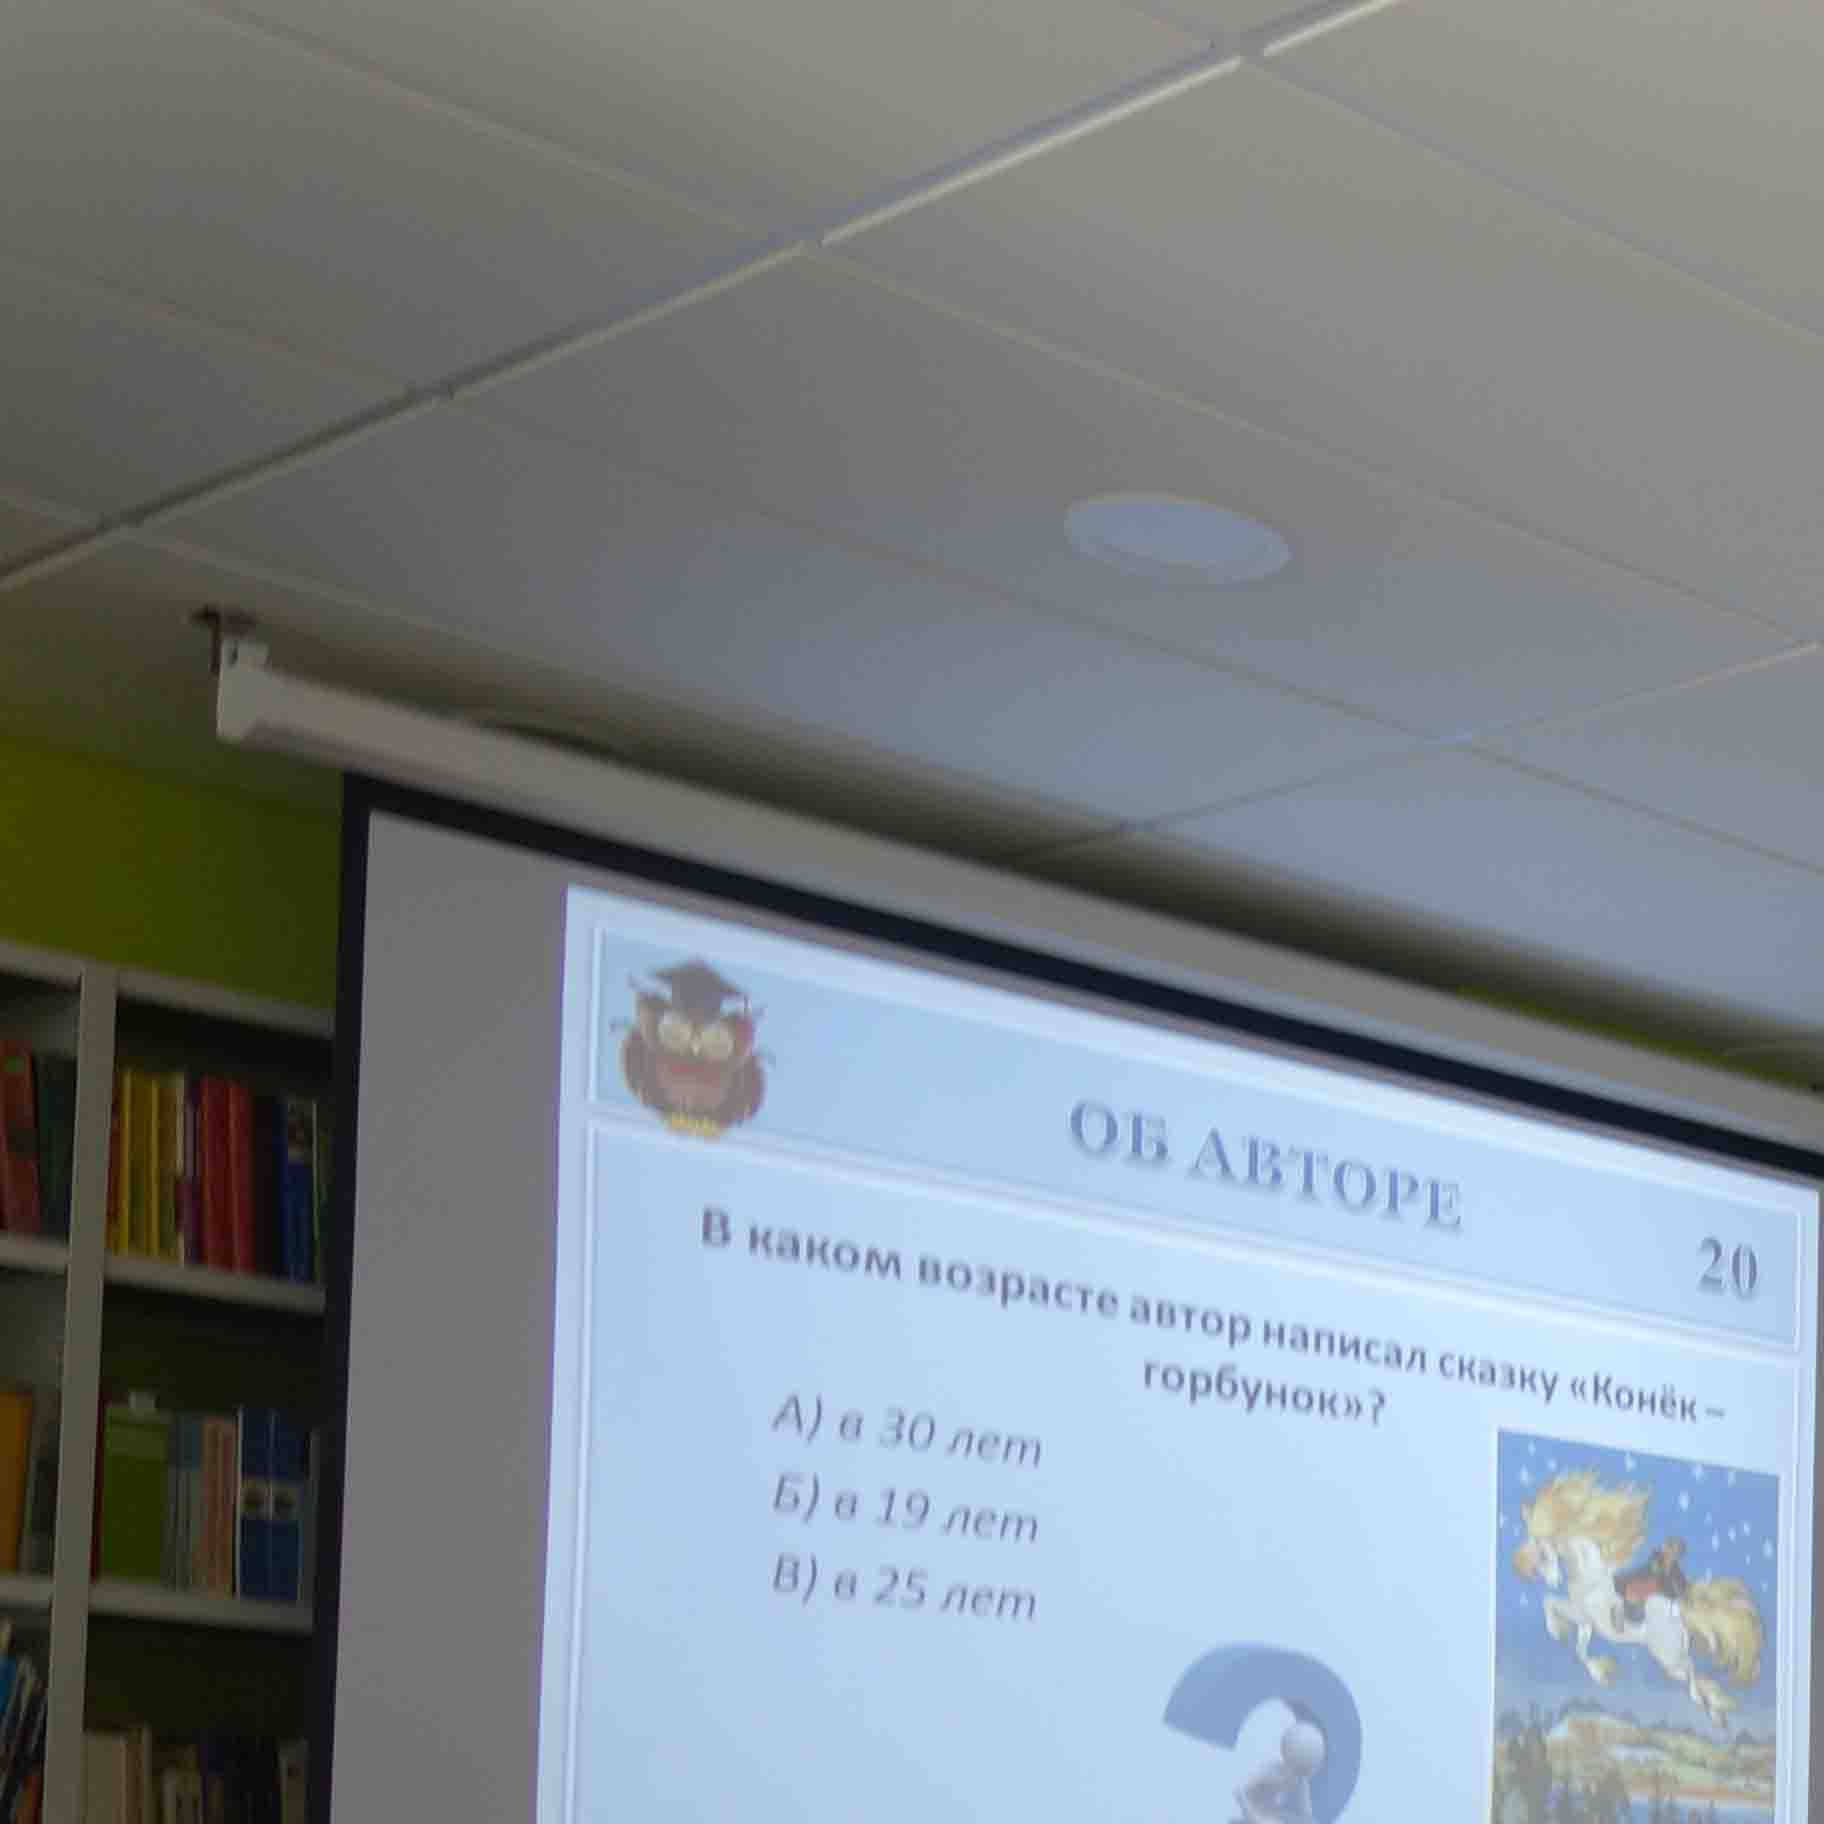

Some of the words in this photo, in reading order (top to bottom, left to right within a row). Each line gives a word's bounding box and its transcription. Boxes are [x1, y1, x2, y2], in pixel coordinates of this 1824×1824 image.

[1069, 1100, 1168, 1163] ОБ
[1190, 1128, 1463, 1229] АВТОРЕ
[1698, 1236, 1758, 1299] 20
[702, 1207, 731, 1247] В
[748, 1224, 902, 1281] каком
[918, 1253, 1118, 1317] возрасте
[1130, 1295, 1252, 1348] автор
[1263, 1318, 1427, 1374] написал
[1438, 1351, 1559, 1405] сказку
[1570, 1371, 1698, 1422] «Конёк
[1143, 1359, 1386, 1426] горбунок»?
[772, 1393, 822, 1446] А)
[839, 1411, 863, 1441] в
[881, 1406, 936, 1452] 30
[946, 1427, 1041, 1468] лет
[773, 1472, 819, 1523] Б)
[835, 1491, 857, 1521] в
[877, 1488, 931, 1529] 19
[943, 1506, 1039, 1542] лет
[773, 1552, 817, 1606] В)
[834, 1570, 857, 1600] в
[874, 1565, 929, 1608] 25
[940, 1585, 1036, 1620] лет
